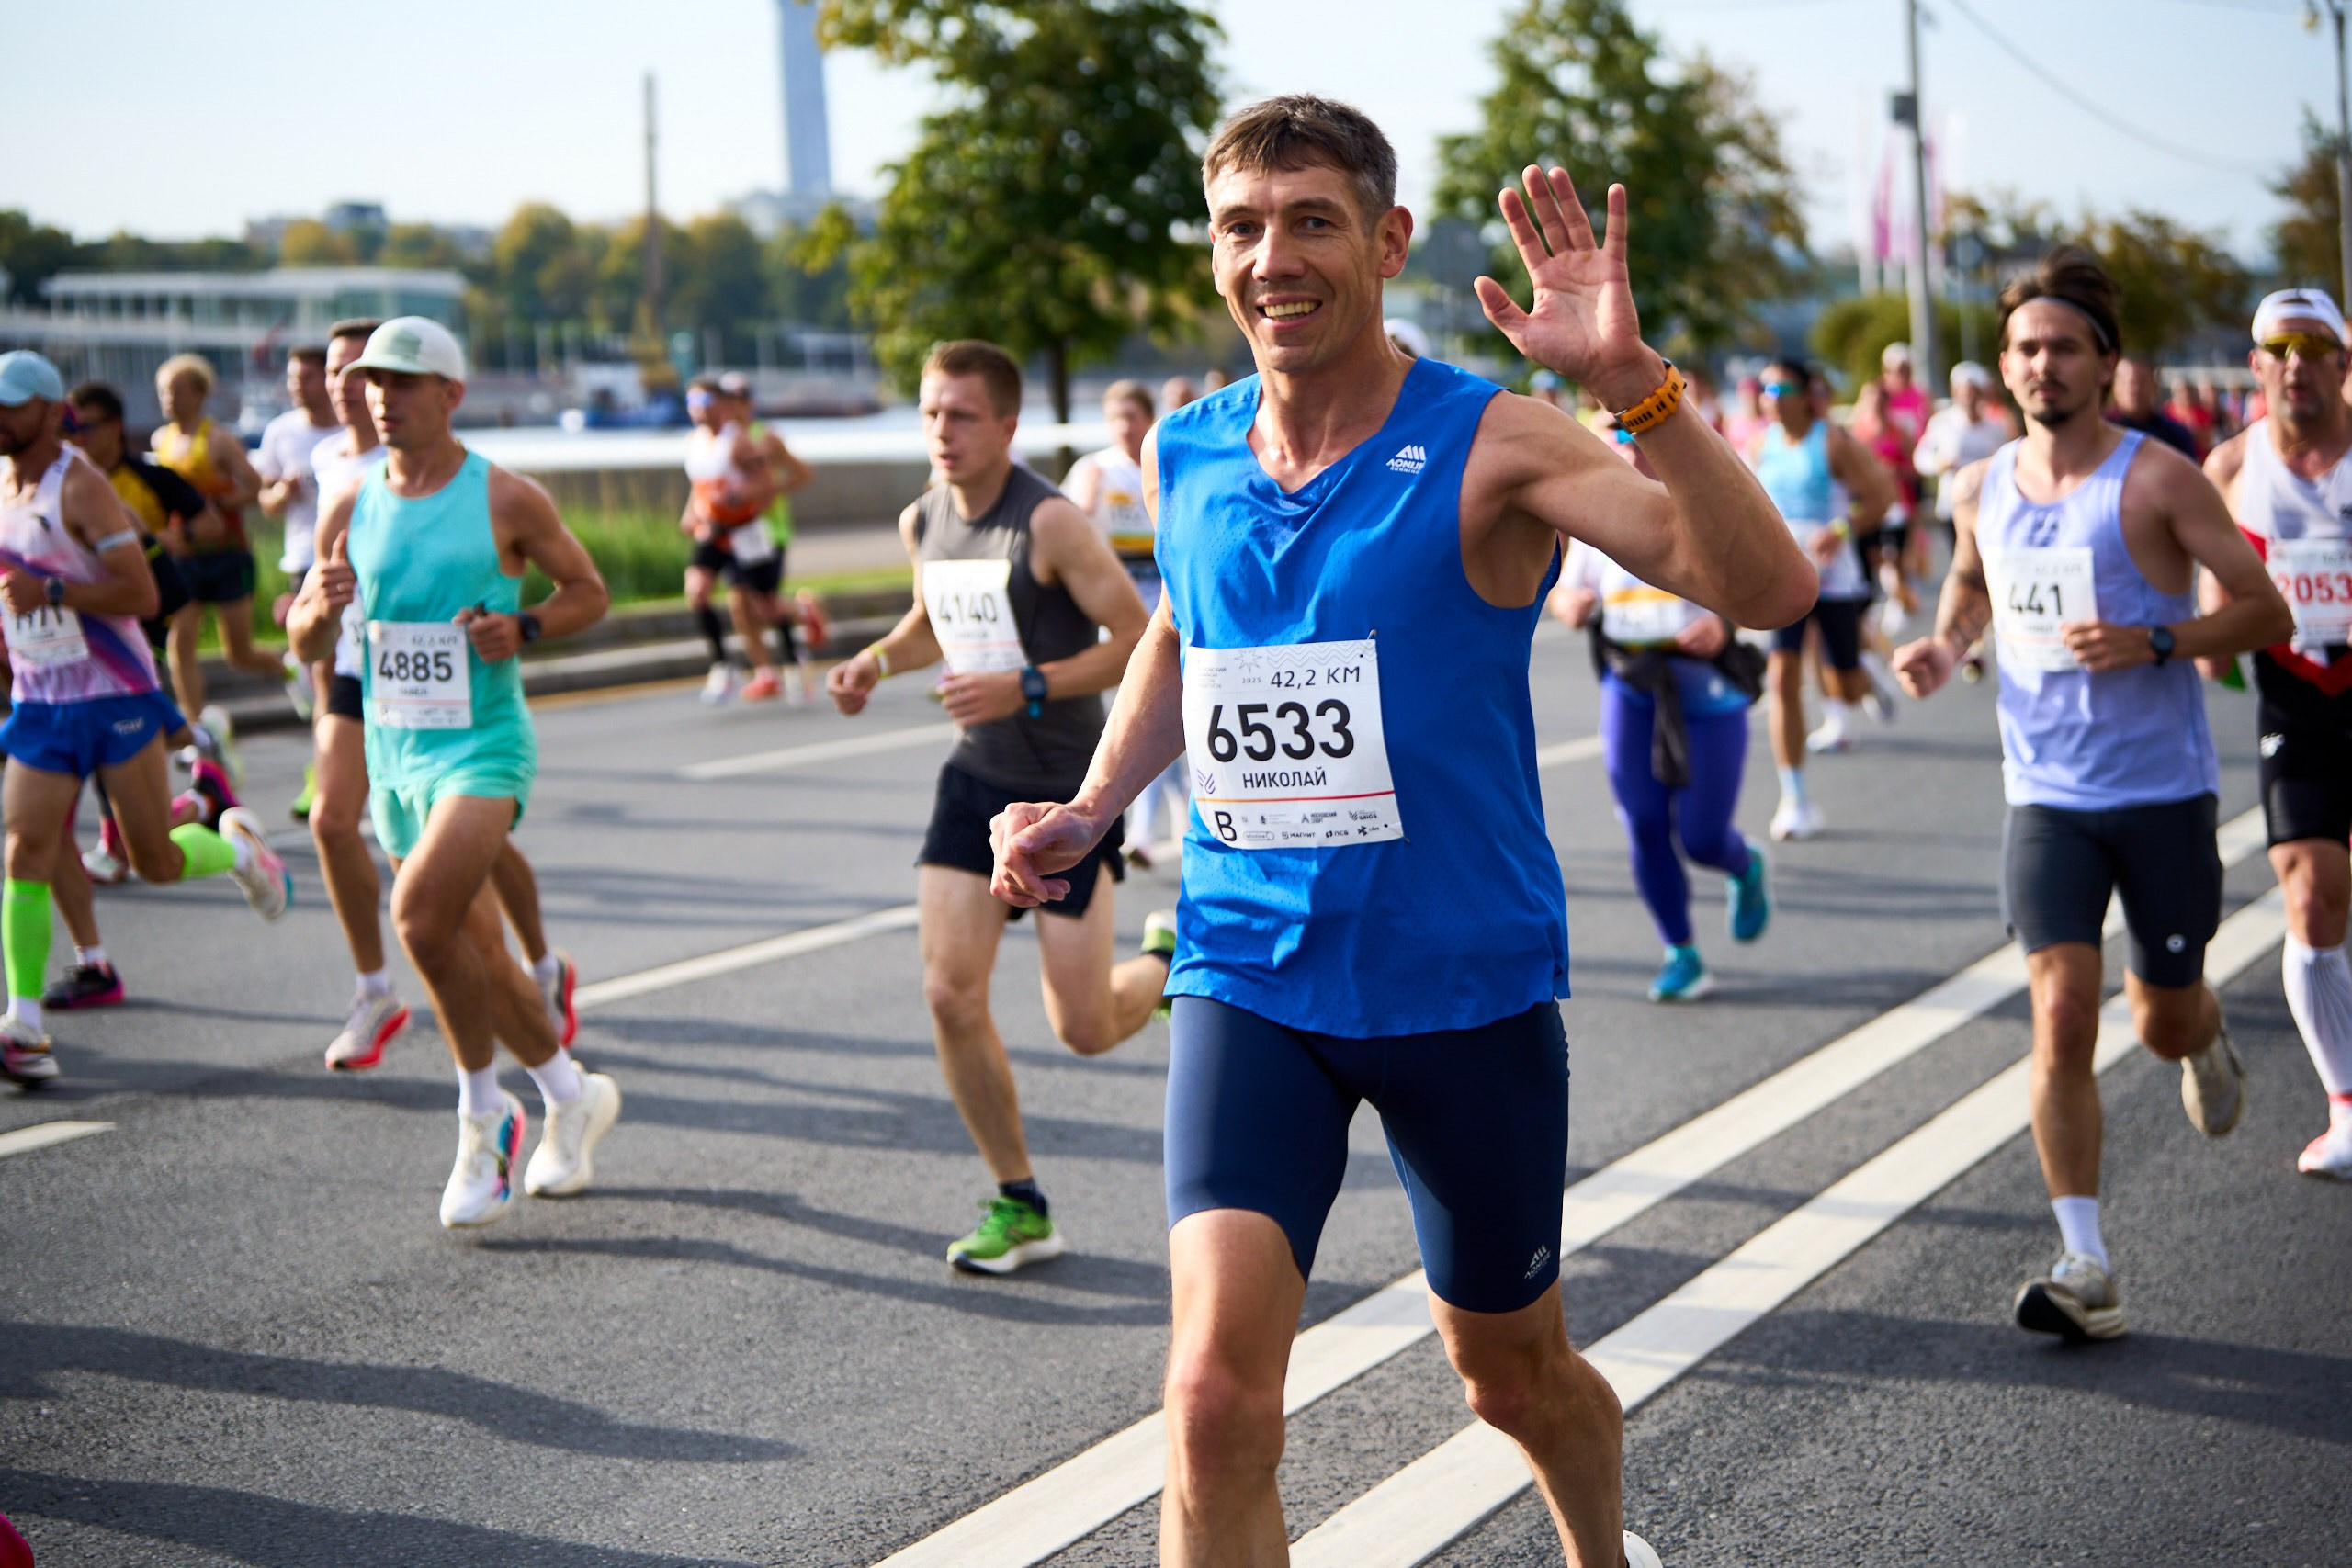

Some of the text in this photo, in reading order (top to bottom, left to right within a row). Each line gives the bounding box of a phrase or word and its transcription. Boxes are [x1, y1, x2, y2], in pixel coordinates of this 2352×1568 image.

[939, 592, 997, 624] 4140
[2008, 581, 2063, 616] 441
[379, 650, 453, 682] 4885
[1271, 669, 1316, 690] 42,2
[1207, 699, 1355, 763] 6533
[1243, 766, 1328, 789] НИКОЛАЙ
